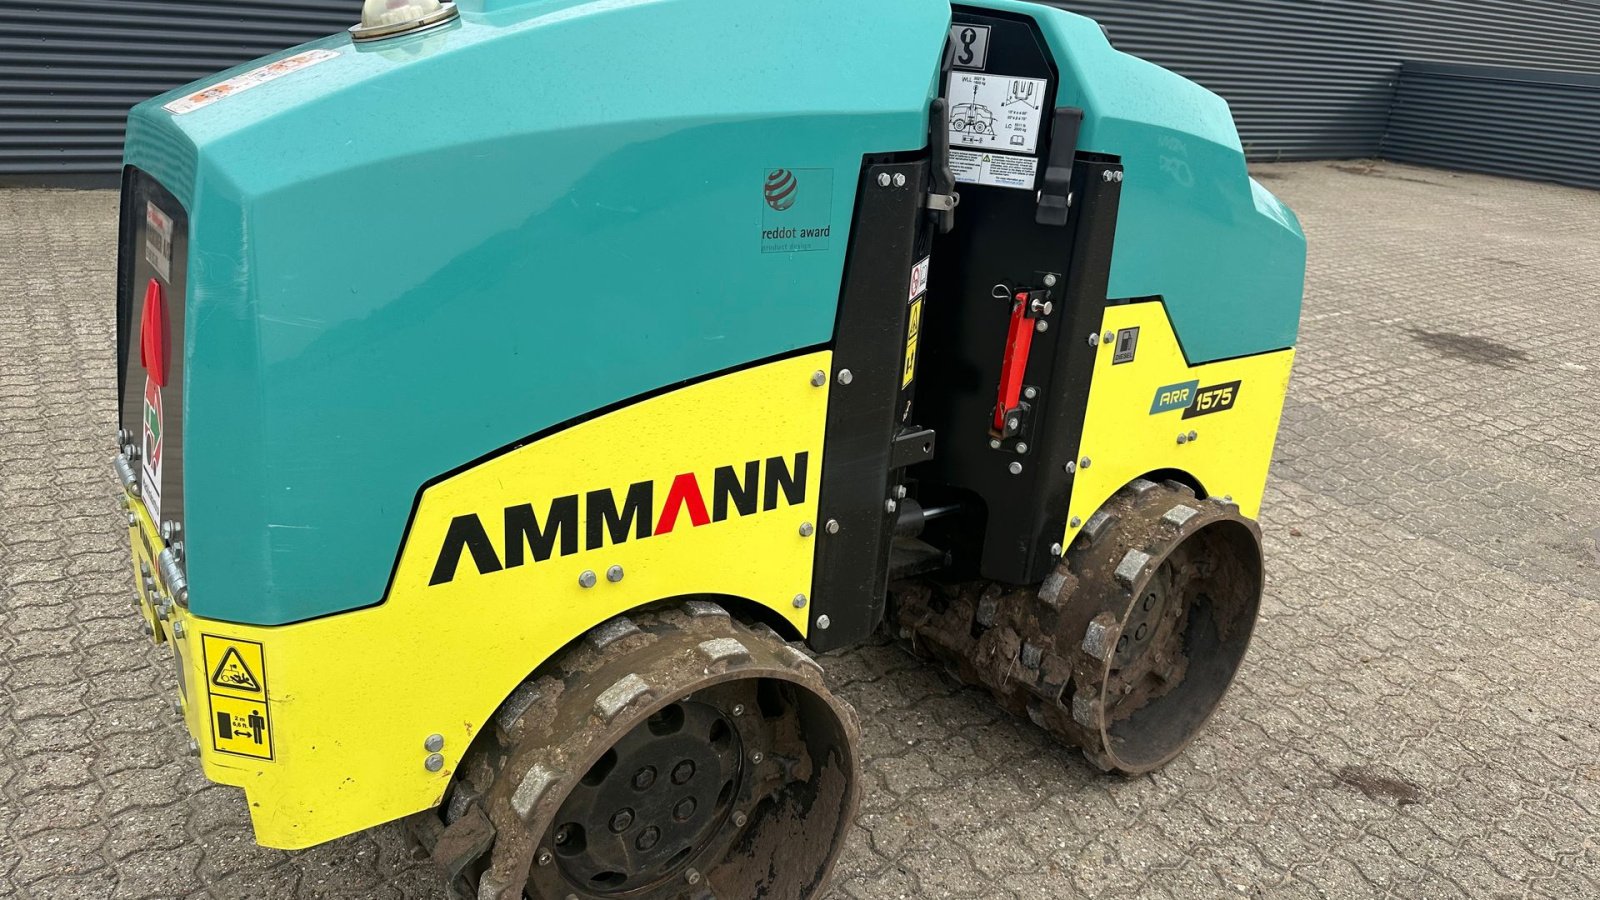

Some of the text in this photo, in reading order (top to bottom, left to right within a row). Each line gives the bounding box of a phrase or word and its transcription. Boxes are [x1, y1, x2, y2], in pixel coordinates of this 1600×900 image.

[762, 225, 830, 240] reddot award
[1115, 352, 1132, 361] DIESEL
[1160, 387, 1233, 411] ARR 1575
[428, 451, 808, 586] AMMANN
